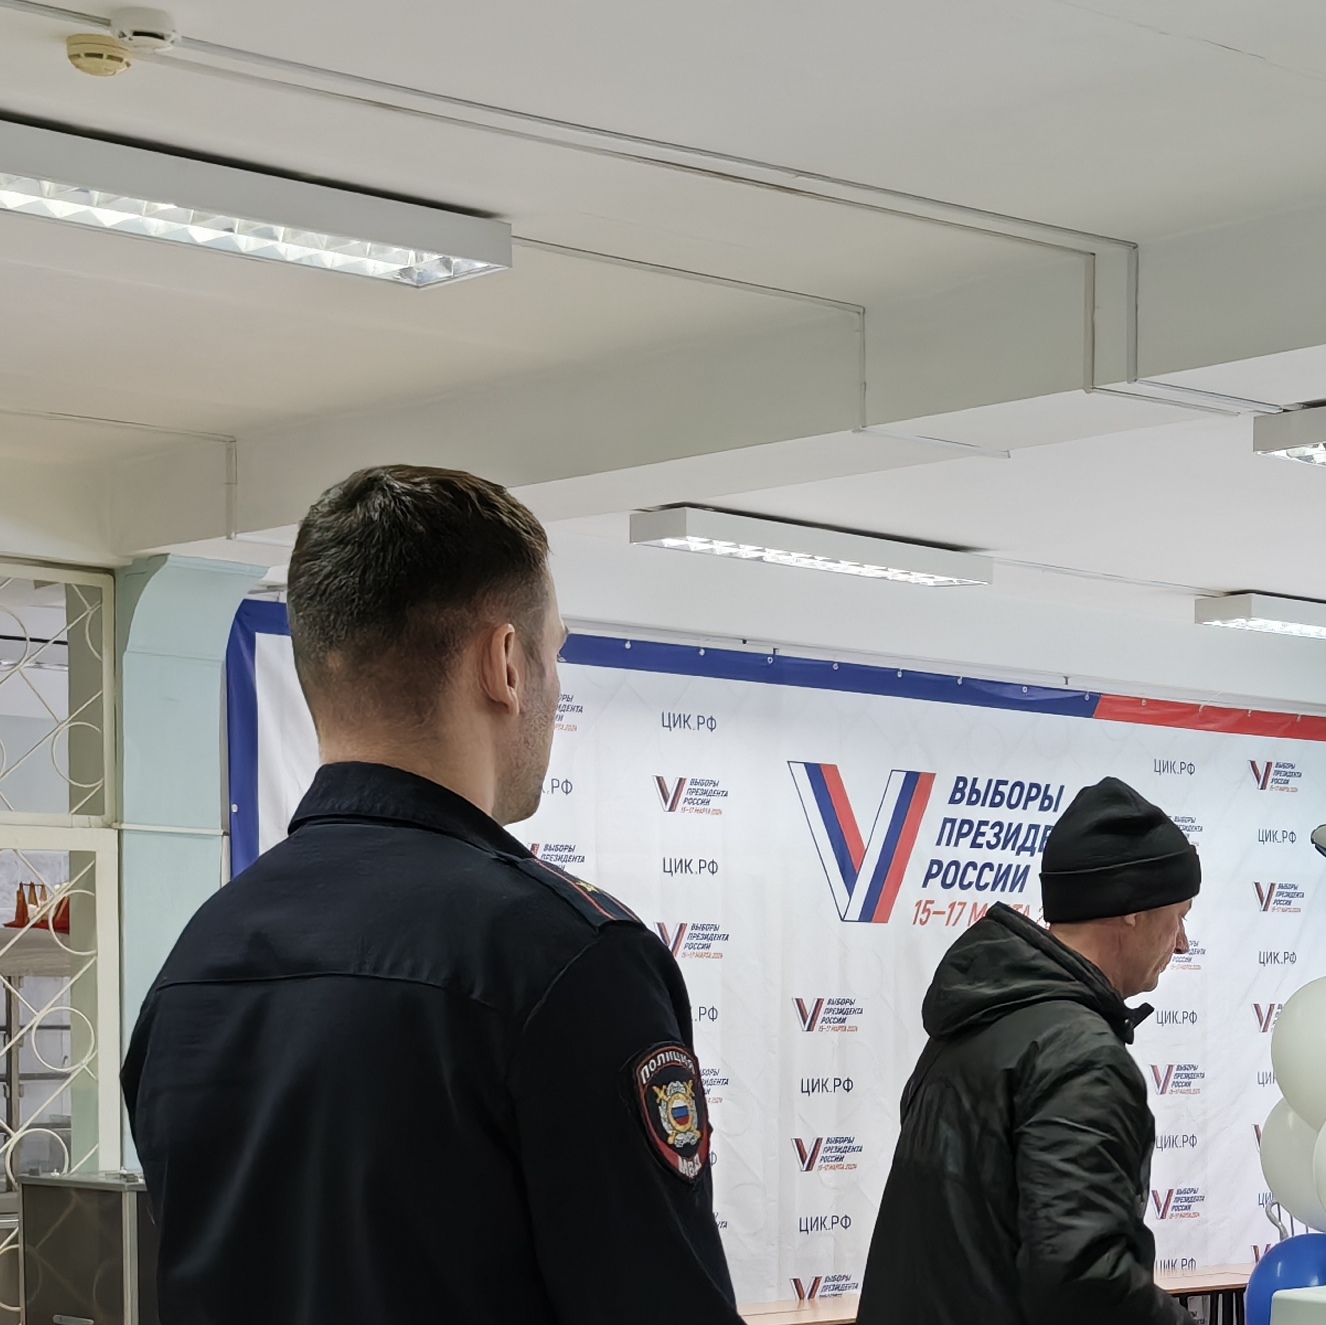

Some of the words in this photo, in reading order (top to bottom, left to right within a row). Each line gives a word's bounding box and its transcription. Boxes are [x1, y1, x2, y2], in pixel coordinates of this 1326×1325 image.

[661, 712, 717, 732] ЦИК.РФ
[1154, 759, 1196, 775] ЦИК.РФ
[947, 776, 1065, 812] ВЫБОРЫ
[935, 817, 1054, 857] ПРЕЗИДЕ
[1258, 828, 1297, 845] ЦИК.РФ
[663, 857, 719, 876] ЦИК.РФ
[921, 858, 1031, 893] РОССИИ
[1258, 951, 1297, 965] ЦИК.РФ
[1156, 1010, 1198, 1026] ЦИК.РФ
[800, 1077, 854, 1096] ЦИК.РФ
[799, 1214, 852, 1234] ЦИК.РФ
